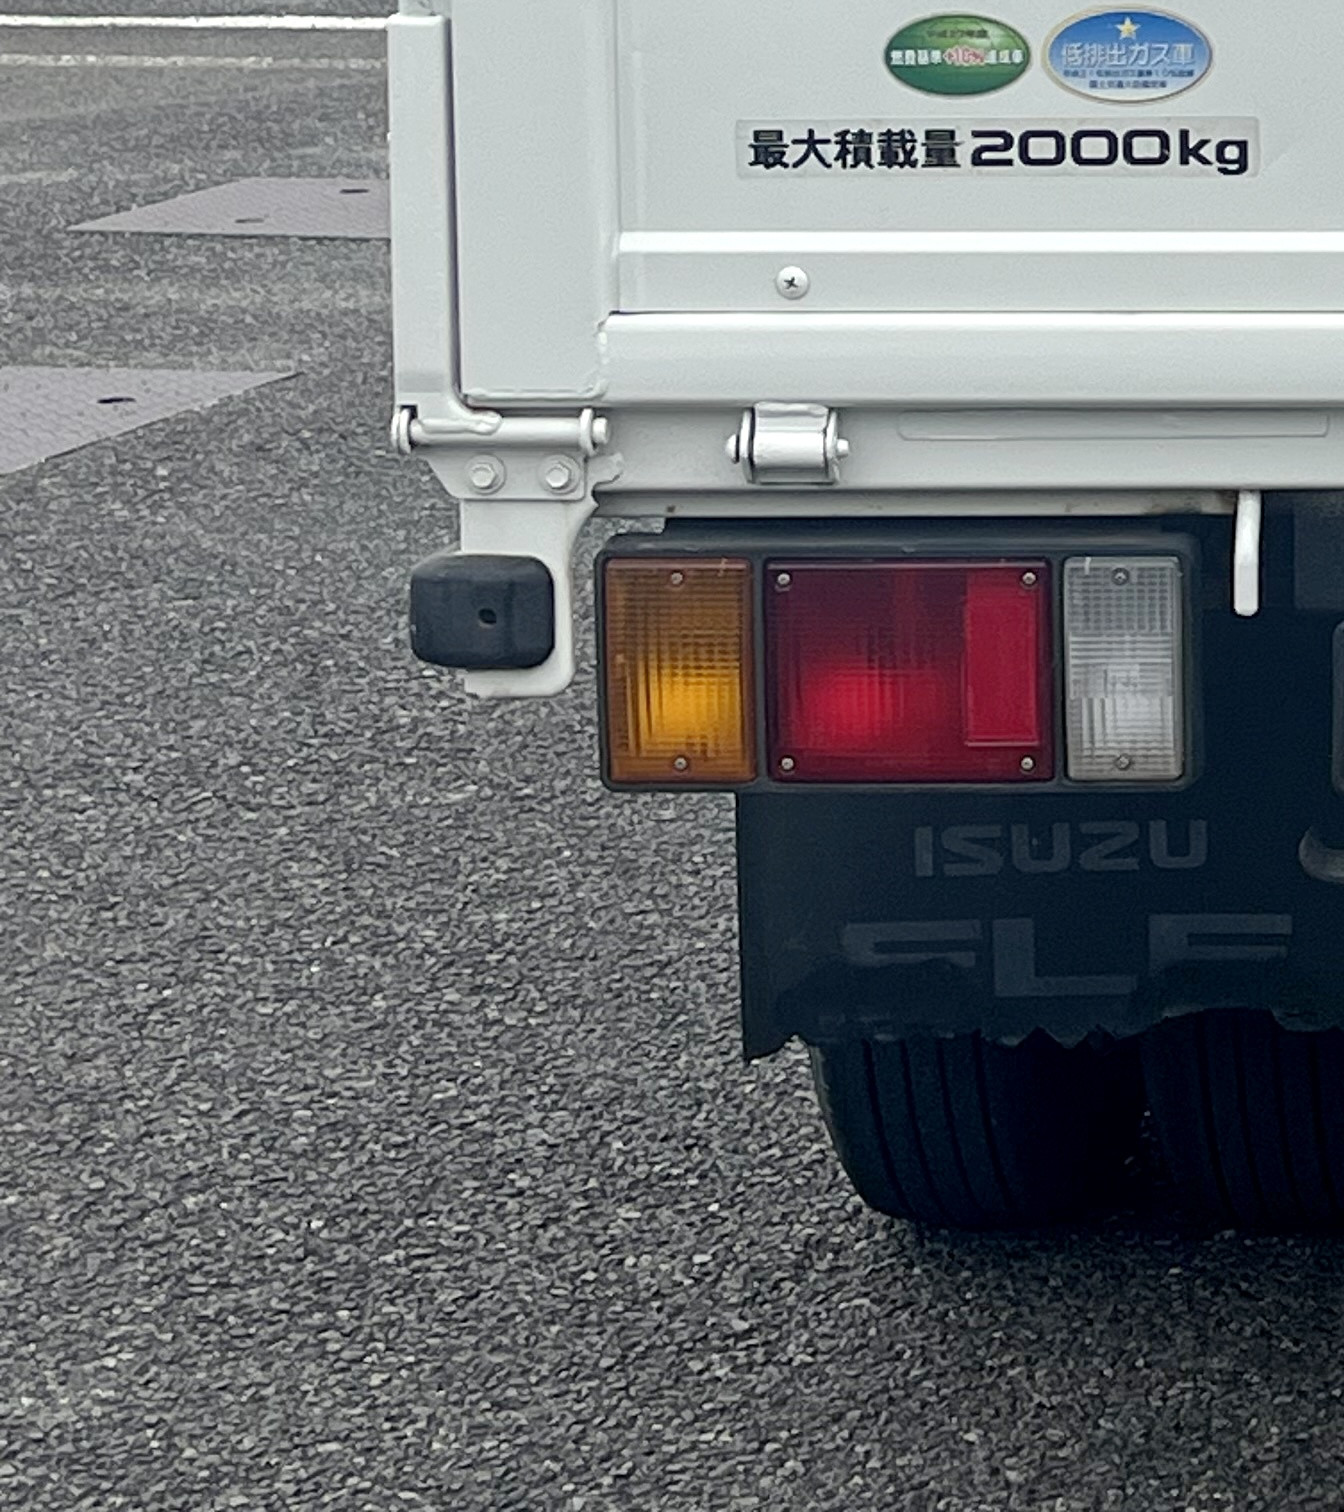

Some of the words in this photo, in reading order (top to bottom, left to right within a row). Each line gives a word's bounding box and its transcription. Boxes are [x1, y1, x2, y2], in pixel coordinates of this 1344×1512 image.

[1061, 42, 1196, 68] 低排出ガス車
[914, 819, 1209, 878] ISUZU
